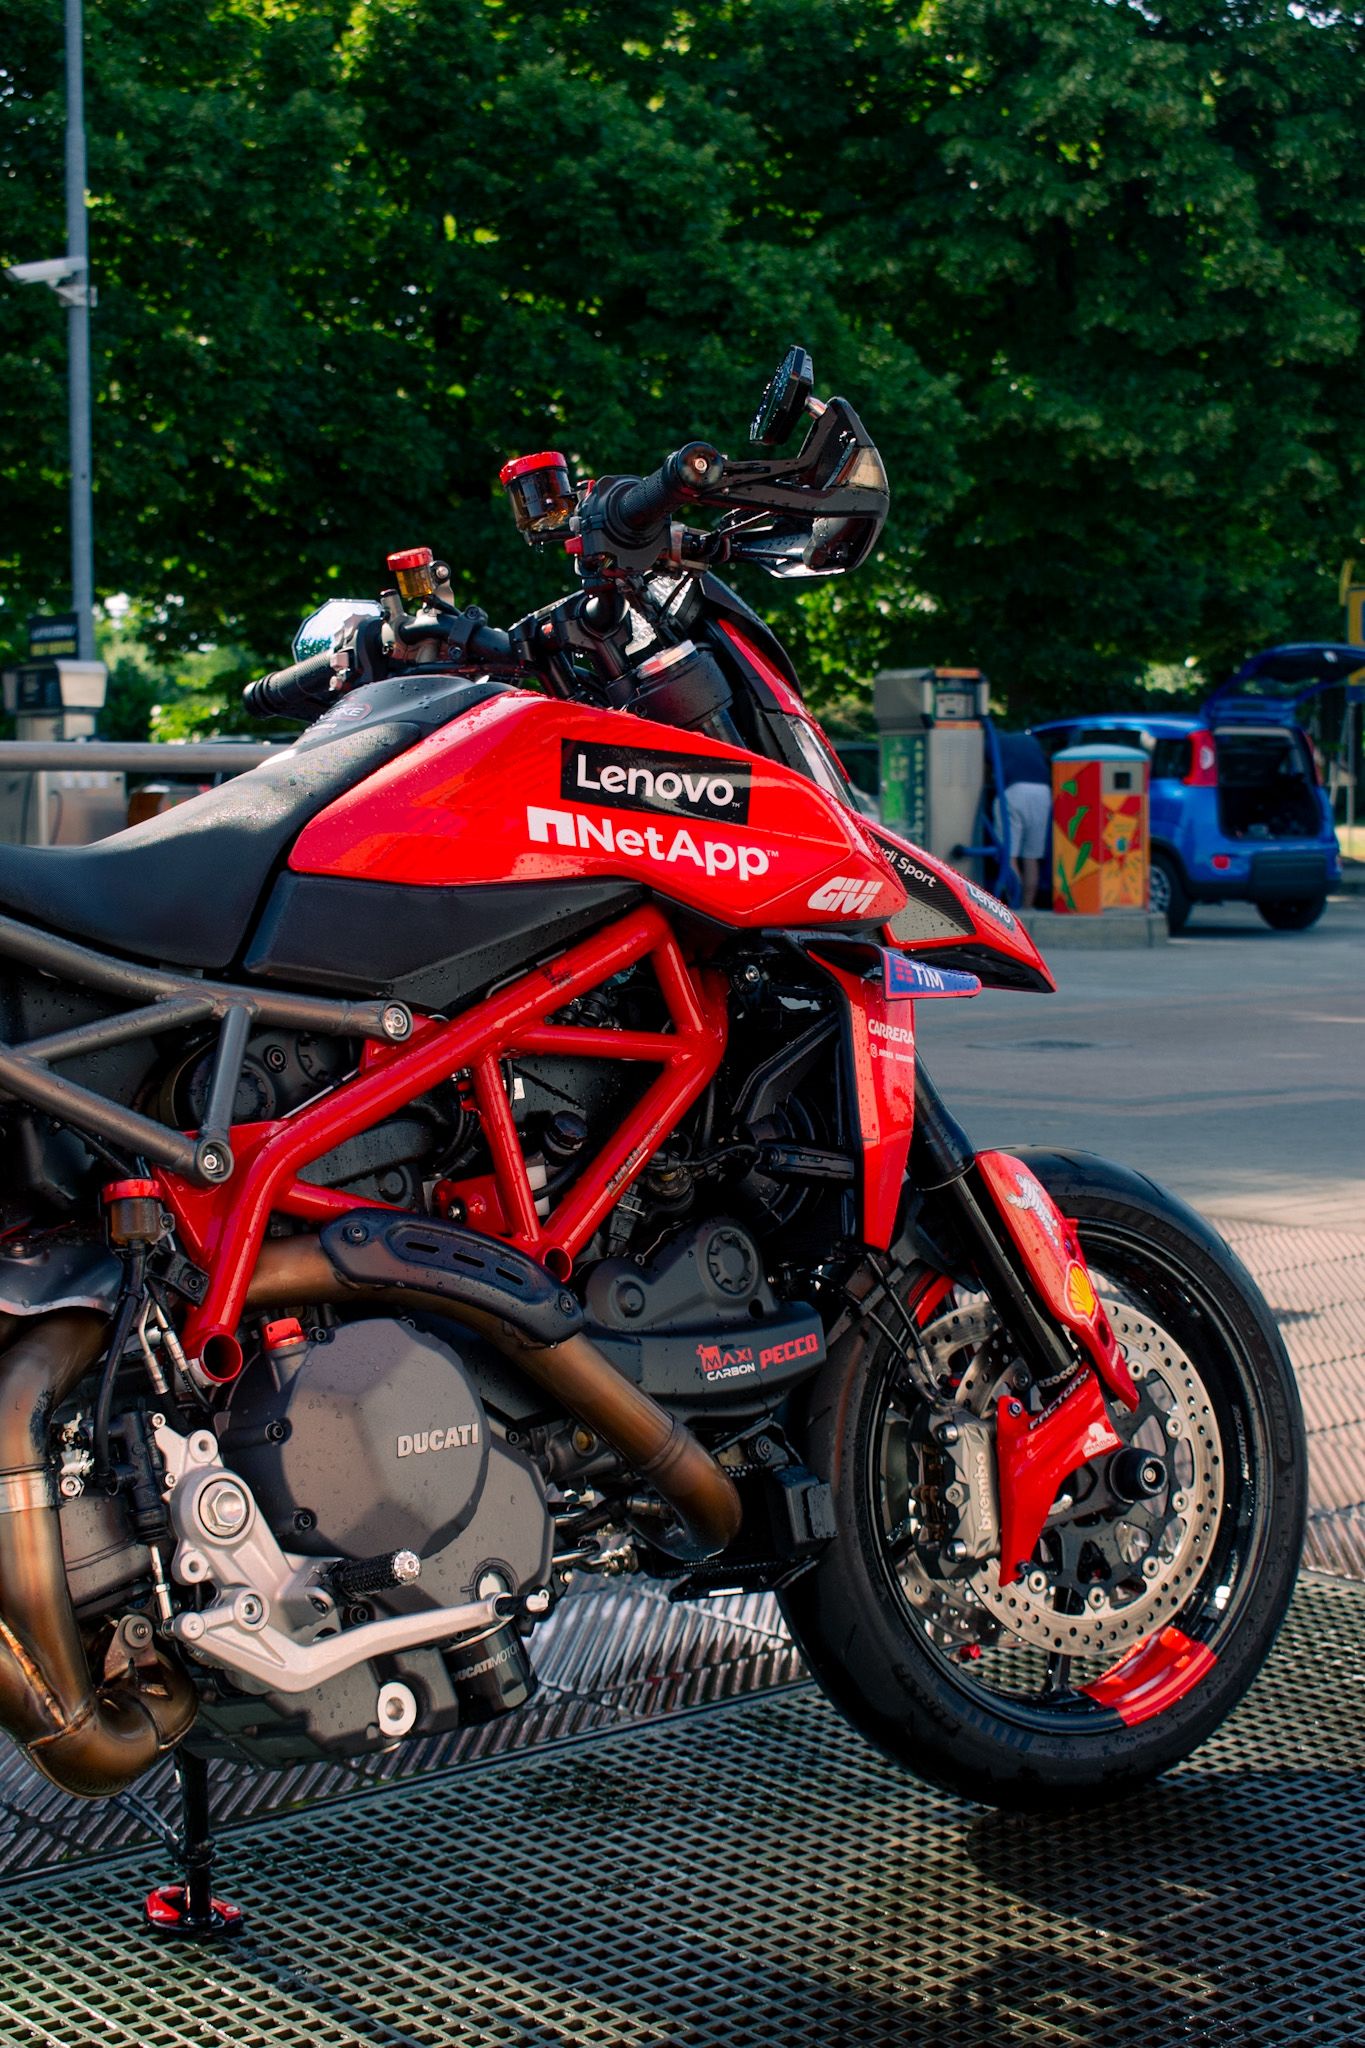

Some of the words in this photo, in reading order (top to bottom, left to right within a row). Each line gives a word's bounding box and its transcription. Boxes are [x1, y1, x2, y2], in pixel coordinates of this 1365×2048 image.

[897, 857, 937, 888] Sport
[807, 876, 884, 914] GIVI
[970, 883, 1012, 925] Lenovo
[911, 964, 944, 990] TIM
[868, 1018, 915, 1046] CARRERA
[701, 1345, 753, 1372] MAXI
[759, 1332, 819, 1370] PECCO
[706, 1362, 756, 1381] CARBON
[1029, 1369, 1089, 1430] FACTORY
[397, 1423, 479, 1457] DUCATI
[974, 1451, 992, 1531] brembo
